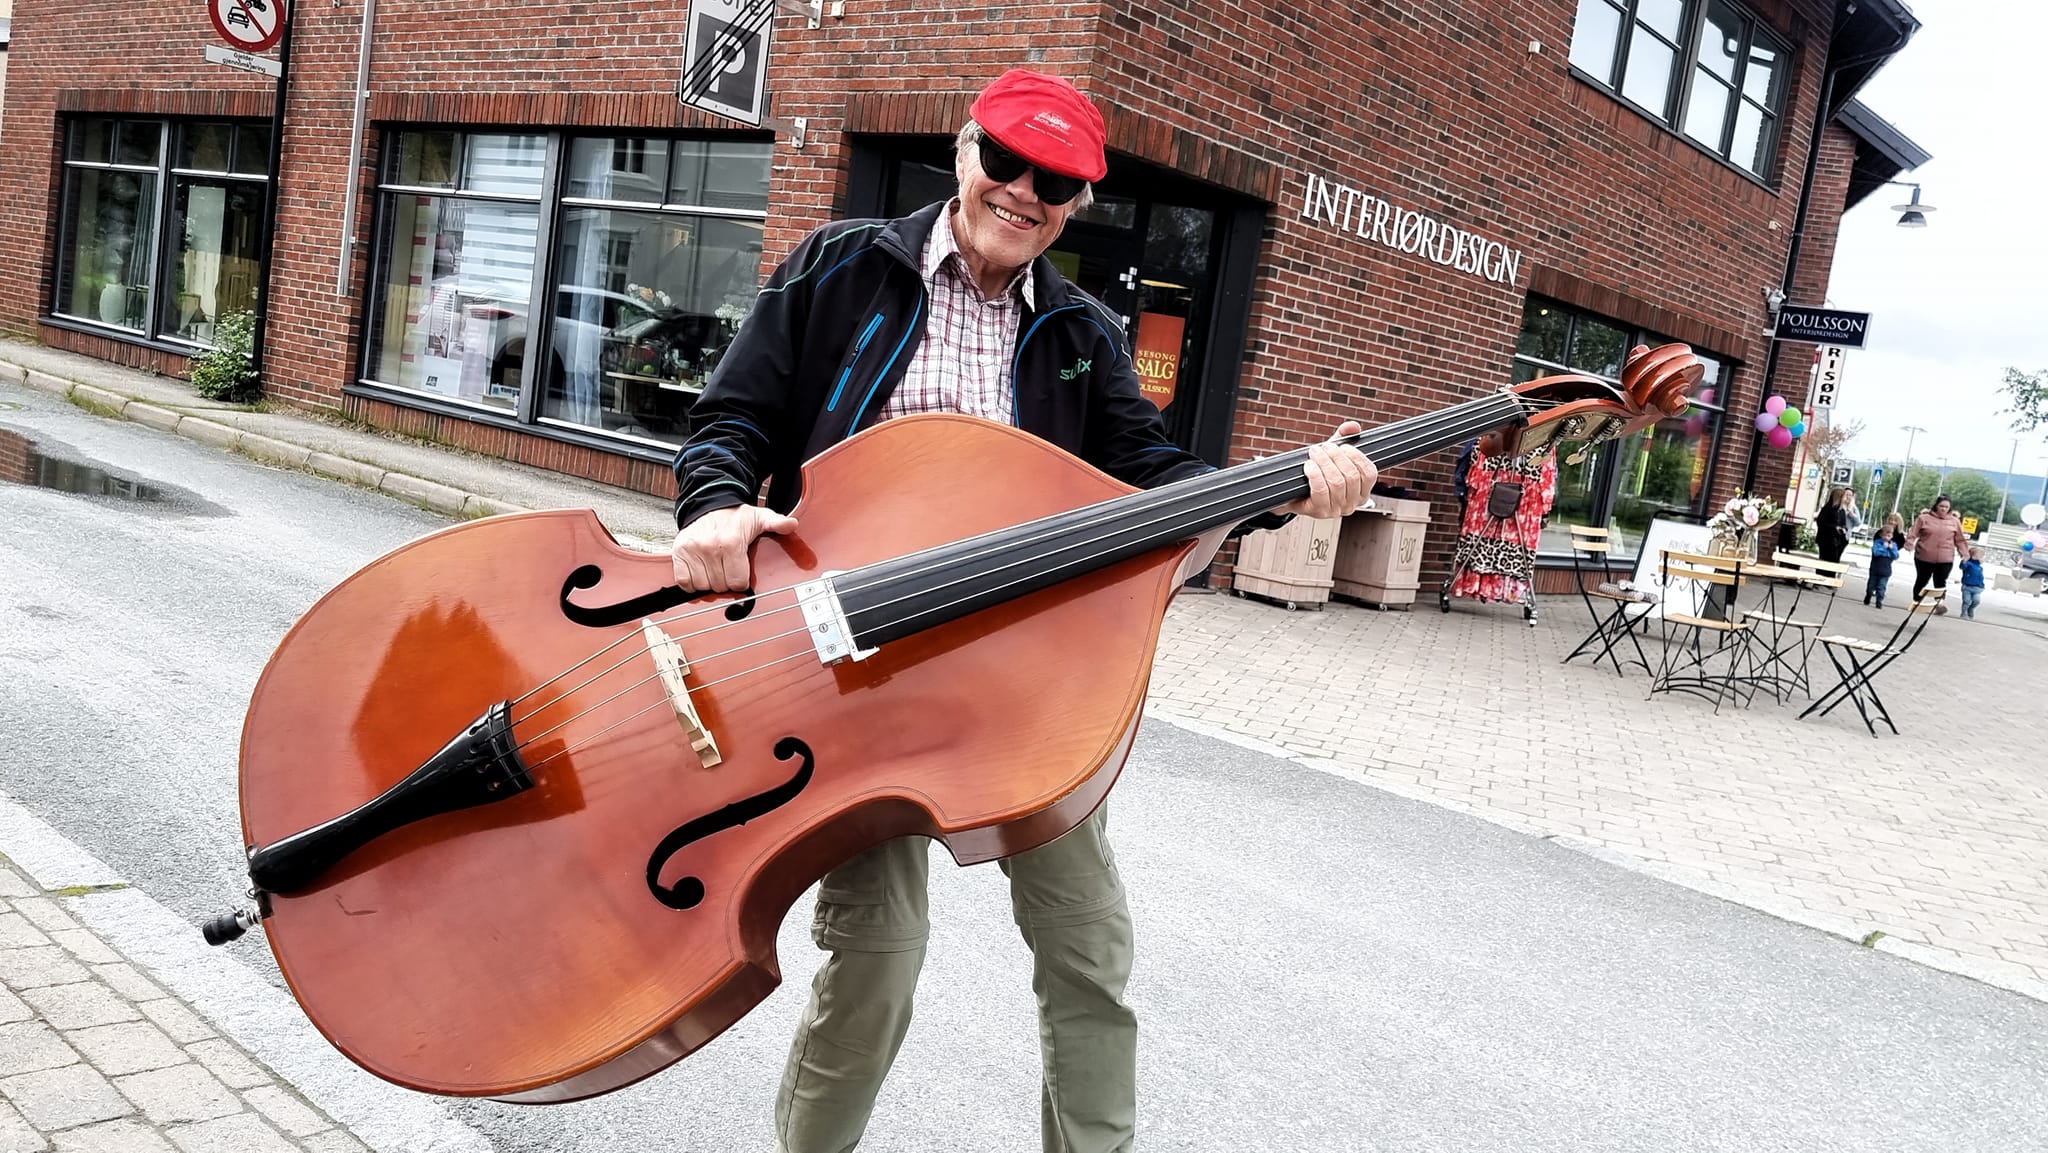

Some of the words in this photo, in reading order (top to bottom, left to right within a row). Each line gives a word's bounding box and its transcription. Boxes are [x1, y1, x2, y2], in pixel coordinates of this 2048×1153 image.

[1302, 172, 1522, 287] INTERIØRDESIGN
[1782, 312, 1865, 333] POULSSON
[1791, 327, 1849, 340] INTERIØRDESIGN
[1137, 350, 1176, 362] SESONG
[1136, 358, 1175, 379] SALG
[1818, 347, 1841, 405] RISØR
[1139, 383, 1171, 395] OULSSON
